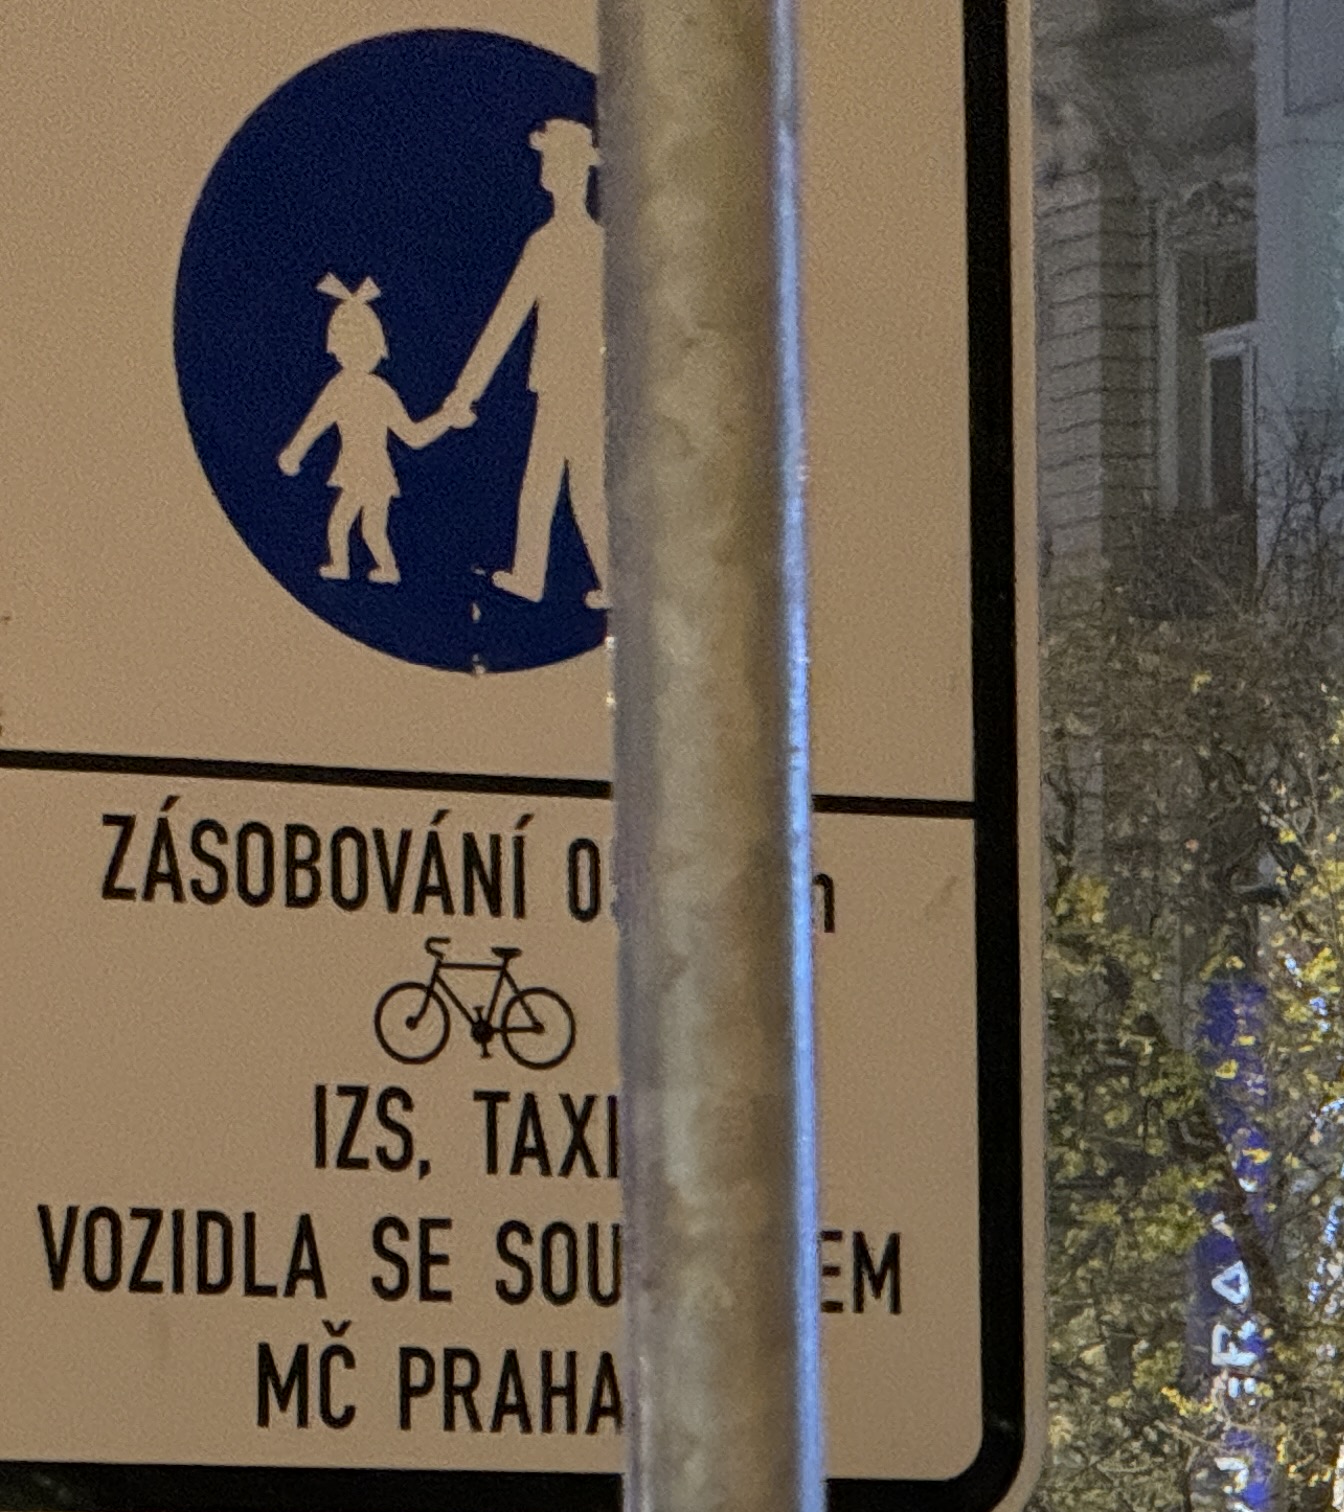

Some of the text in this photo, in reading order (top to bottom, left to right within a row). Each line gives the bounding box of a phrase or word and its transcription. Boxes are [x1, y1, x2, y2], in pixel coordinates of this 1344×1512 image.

[101, 795, 534, 920] ZÁSOBOVÁNÍ
[314, 1083, 619, 1180] IZS, TAXI
[37, 1204, 902, 1315] VOZIDLA SE SOUEM
[257, 1319, 624, 1435] MČ PRAHA
